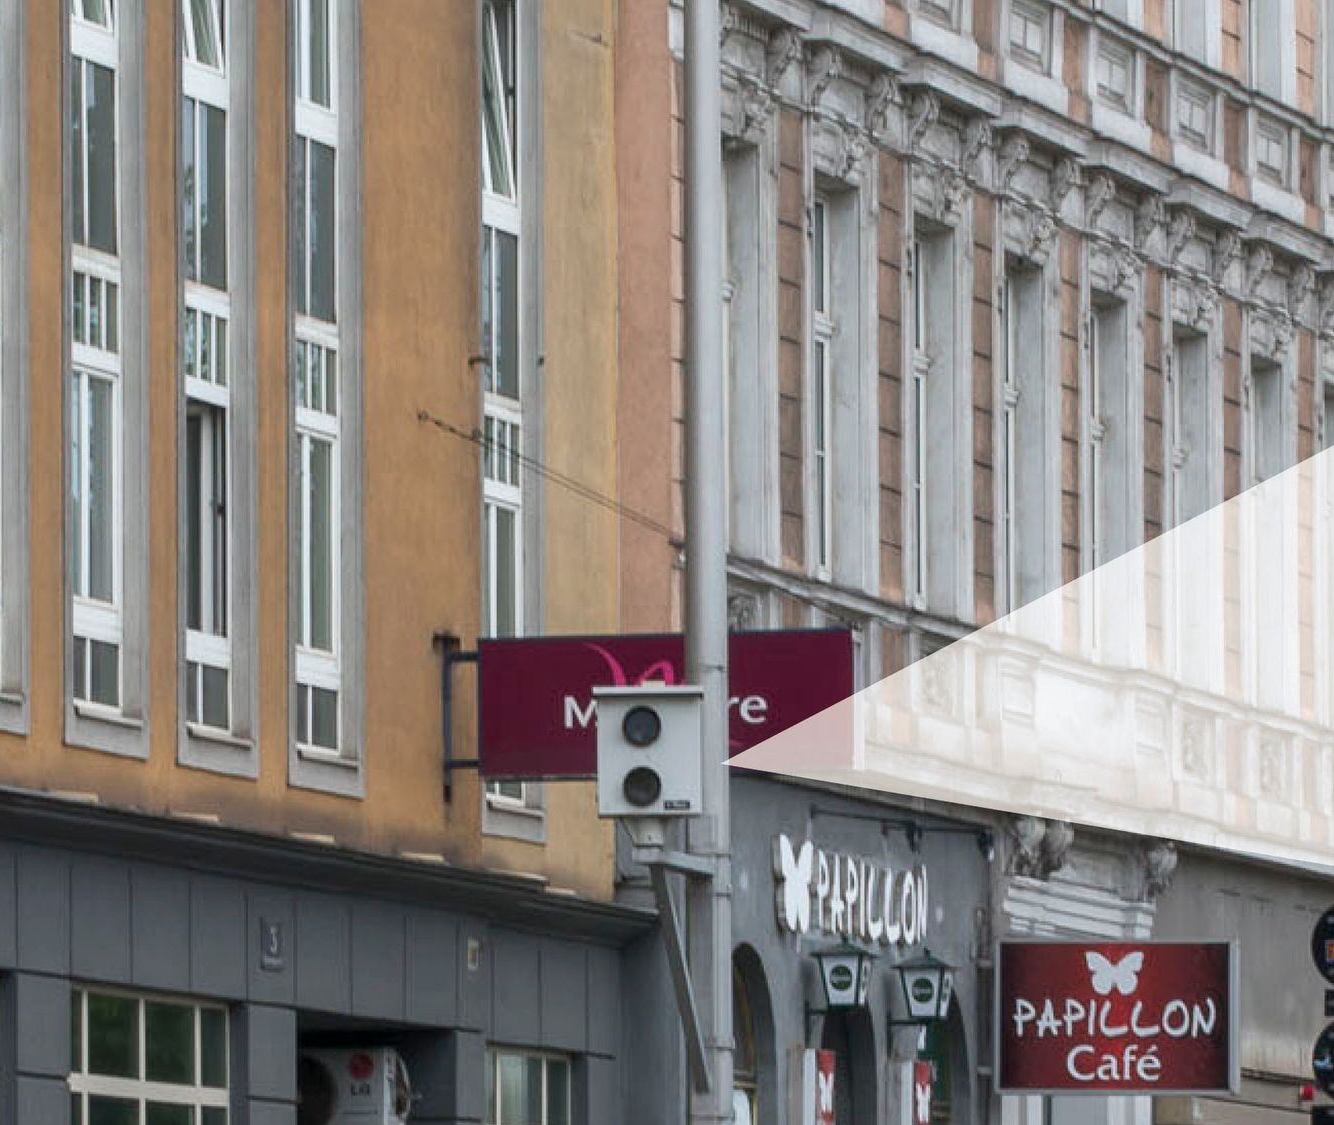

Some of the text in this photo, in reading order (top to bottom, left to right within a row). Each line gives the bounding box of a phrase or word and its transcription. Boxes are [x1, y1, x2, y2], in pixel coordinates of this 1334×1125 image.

[816, 849, 927, 946] PAPILLON
[1012, 996, 1217, 1038] PAPILLON
[1066, 1044, 1162, 1081] Café
